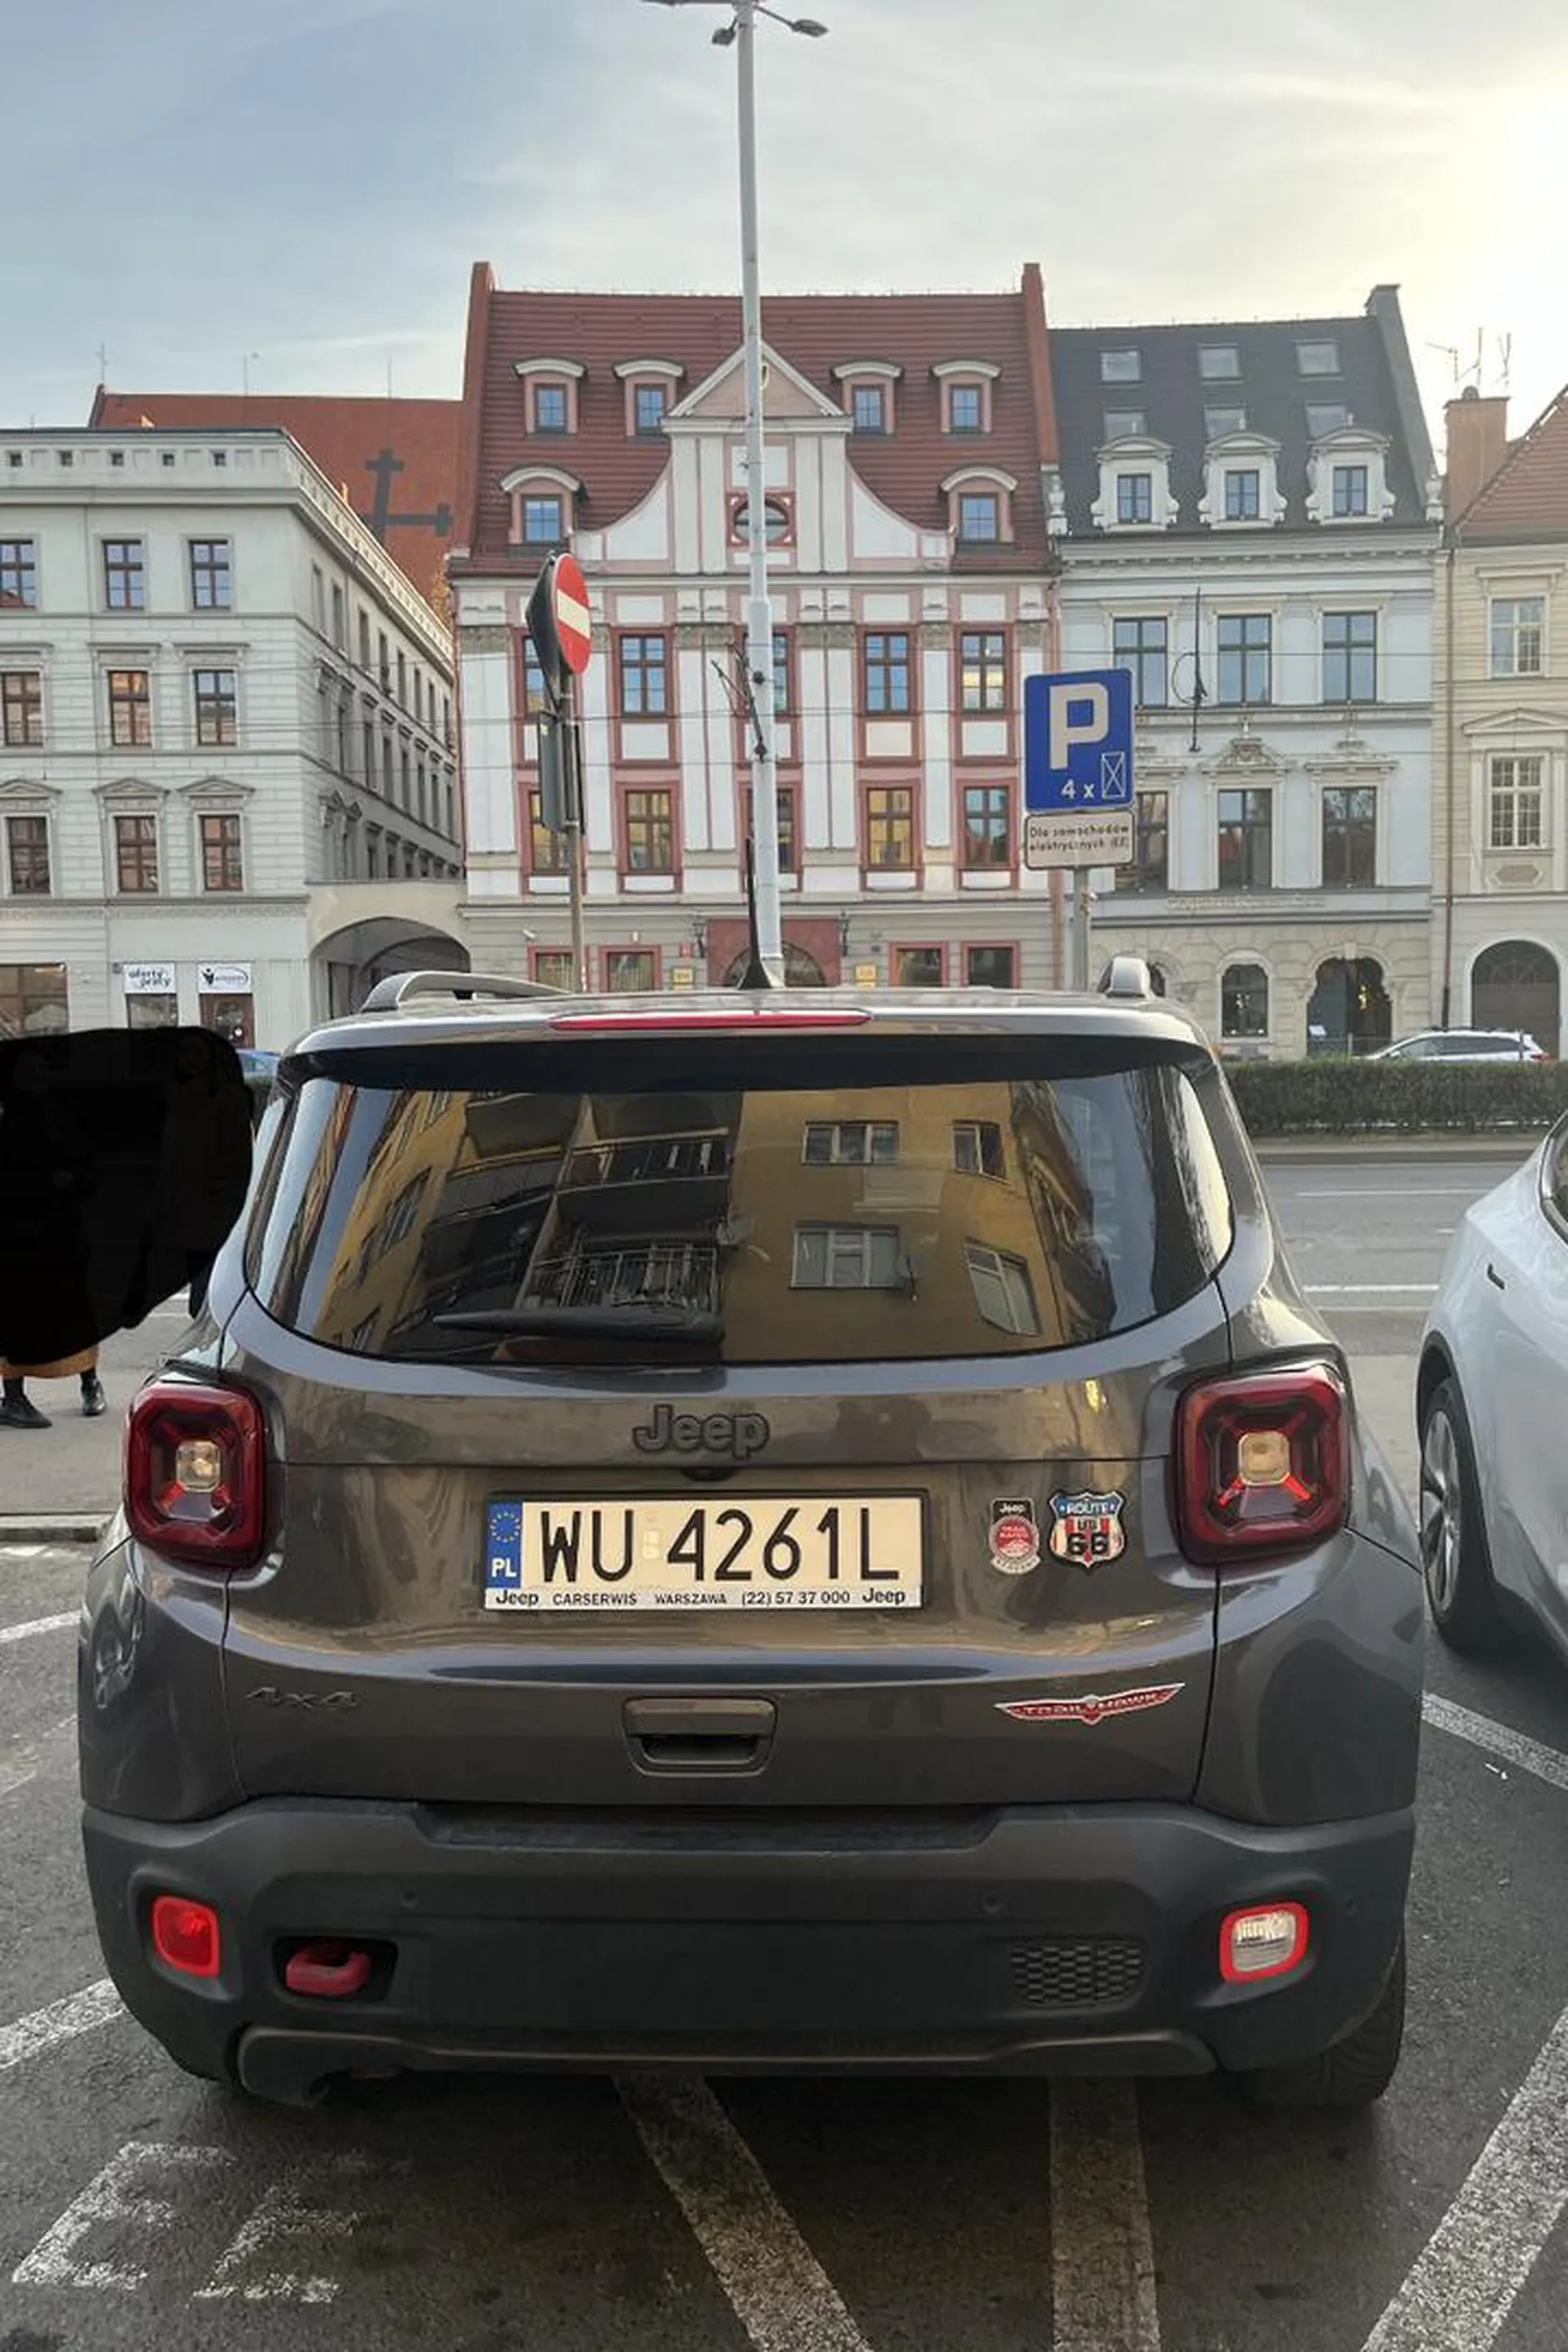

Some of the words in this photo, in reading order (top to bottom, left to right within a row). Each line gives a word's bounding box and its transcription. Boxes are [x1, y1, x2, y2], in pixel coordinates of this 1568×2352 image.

[1050, 682, 1109, 770] P
[1060, 779, 1076, 799] 4
[632, 1404, 770, 1460] Jeep
[1066, 1502, 1108, 1515] ROUTE
[540, 1509, 633, 1582] WU
[667, 1507, 900, 1581] 4261L
[1067, 1533, 1109, 1555] 66
[491, 1557, 516, 1578] PL
[495, 1588, 540, 1606] Jeep
[552, 1591, 638, 1606] CARSERWIS
[655, 1592, 727, 1605] WARSZAWA
[741, 1591, 772, 1606] (22)
[776, 1590, 795, 1604] 57
[798, 1590, 817, 1604] 37
[820, 1590, 850, 1604] 000
[862, 1587, 906, 1605] Jeep
